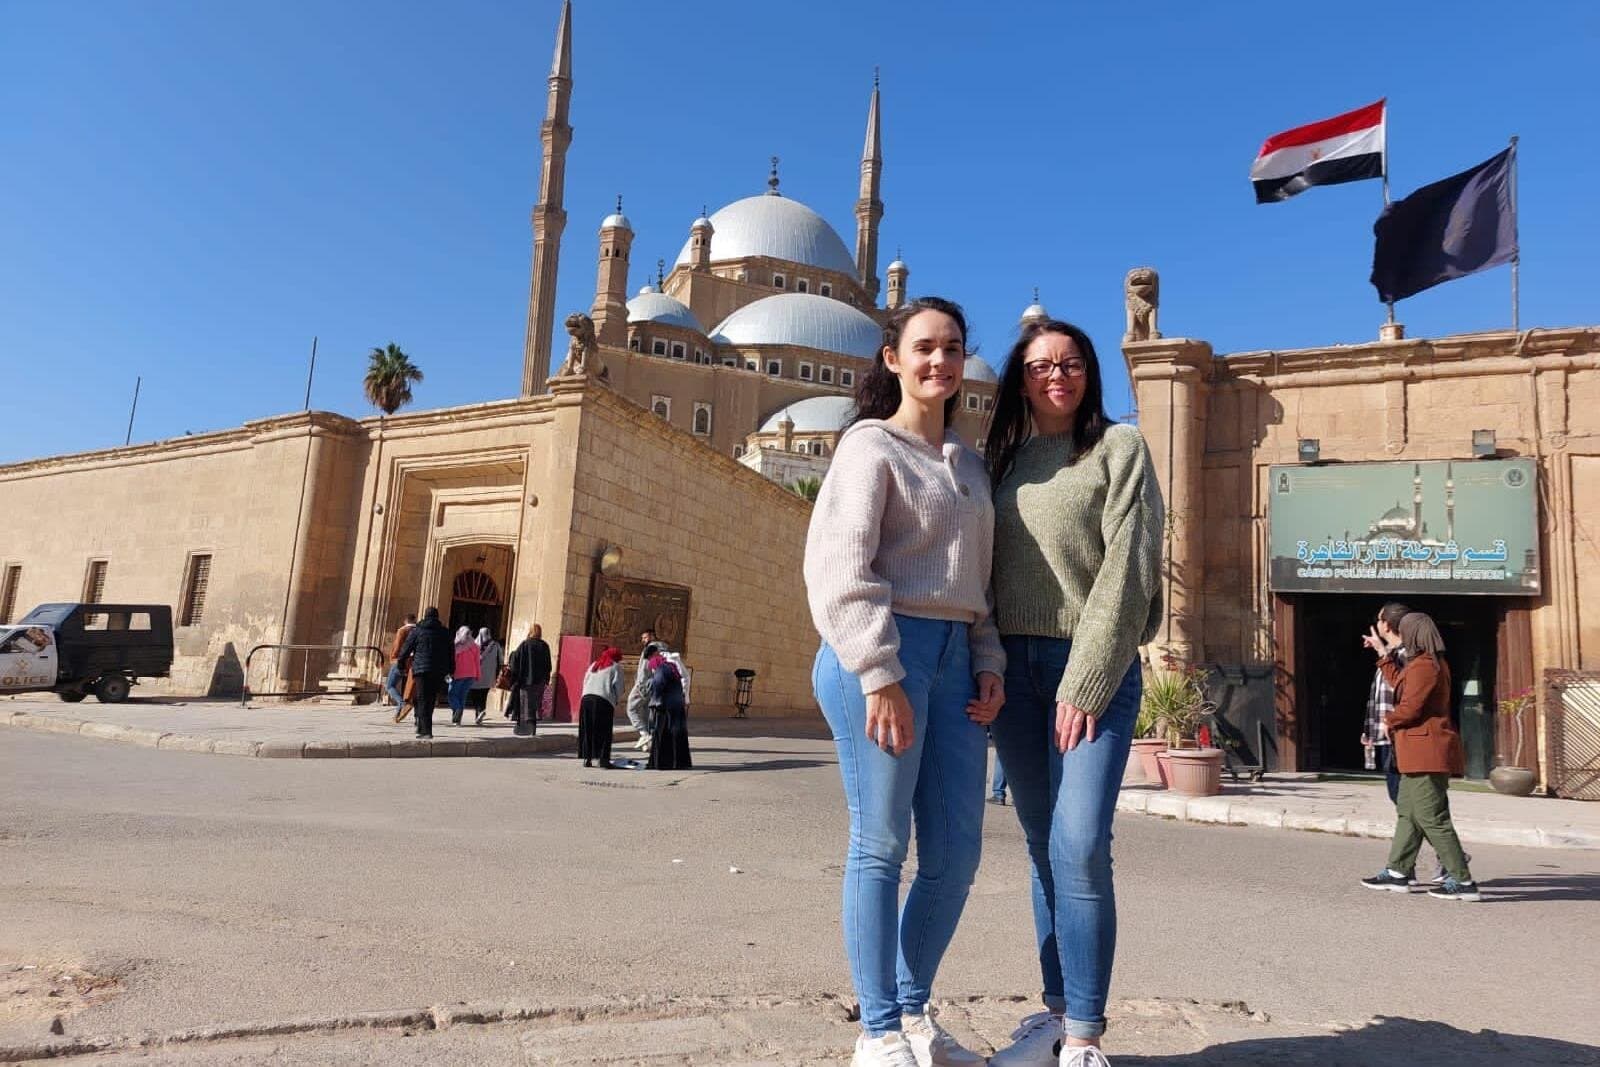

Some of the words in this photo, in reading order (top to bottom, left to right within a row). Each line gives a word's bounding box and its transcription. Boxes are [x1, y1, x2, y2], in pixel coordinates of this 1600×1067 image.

[1296, 540, 1360, 565] القاهرة
[1397, 539, 1458, 566] شرطة
[1462, 539, 1507, 566] قسم
[1297, 567, 1333, 578] CAIRO
[1334, 568, 1376, 579] POLICE
[0, 675, 49, 686] OLICE
